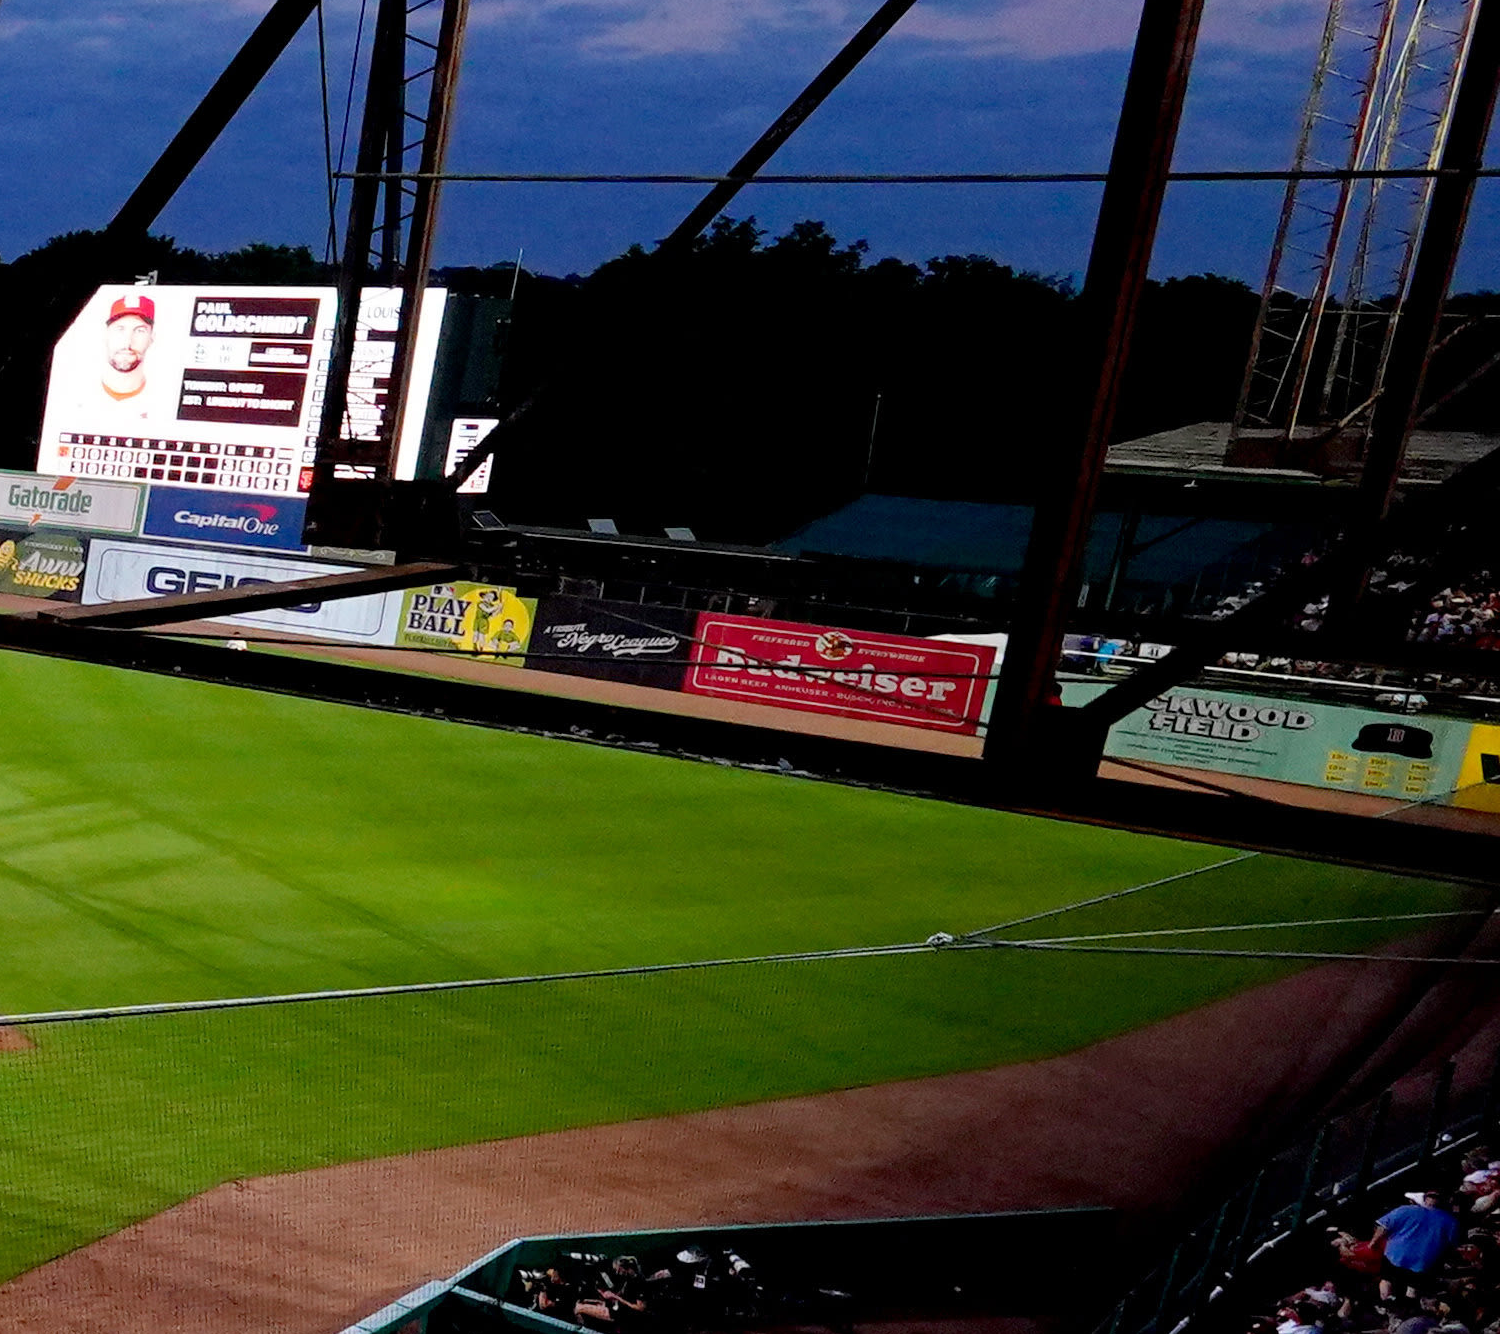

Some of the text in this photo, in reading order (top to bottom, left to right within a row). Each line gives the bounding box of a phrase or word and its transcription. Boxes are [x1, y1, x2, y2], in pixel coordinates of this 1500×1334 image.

[197, 302, 232, 314] PAUL
[195, 314, 308, 335] GOLDSCHMIDT
[9, 485, 92, 513] Gatorade
[13, 570, 80, 592] SHUCKS
[413, 595, 472, 617] PLAY
[405, 612, 466, 636] BALL
[557, 631, 679, 657] Negro Leagues
[752, 634, 810, 647] PREFERRED
[712, 647, 956, 701] Budweiser
[1145, 696, 1315, 730] CKWOOD
[1150, 713, 1260, 742] FIELD
